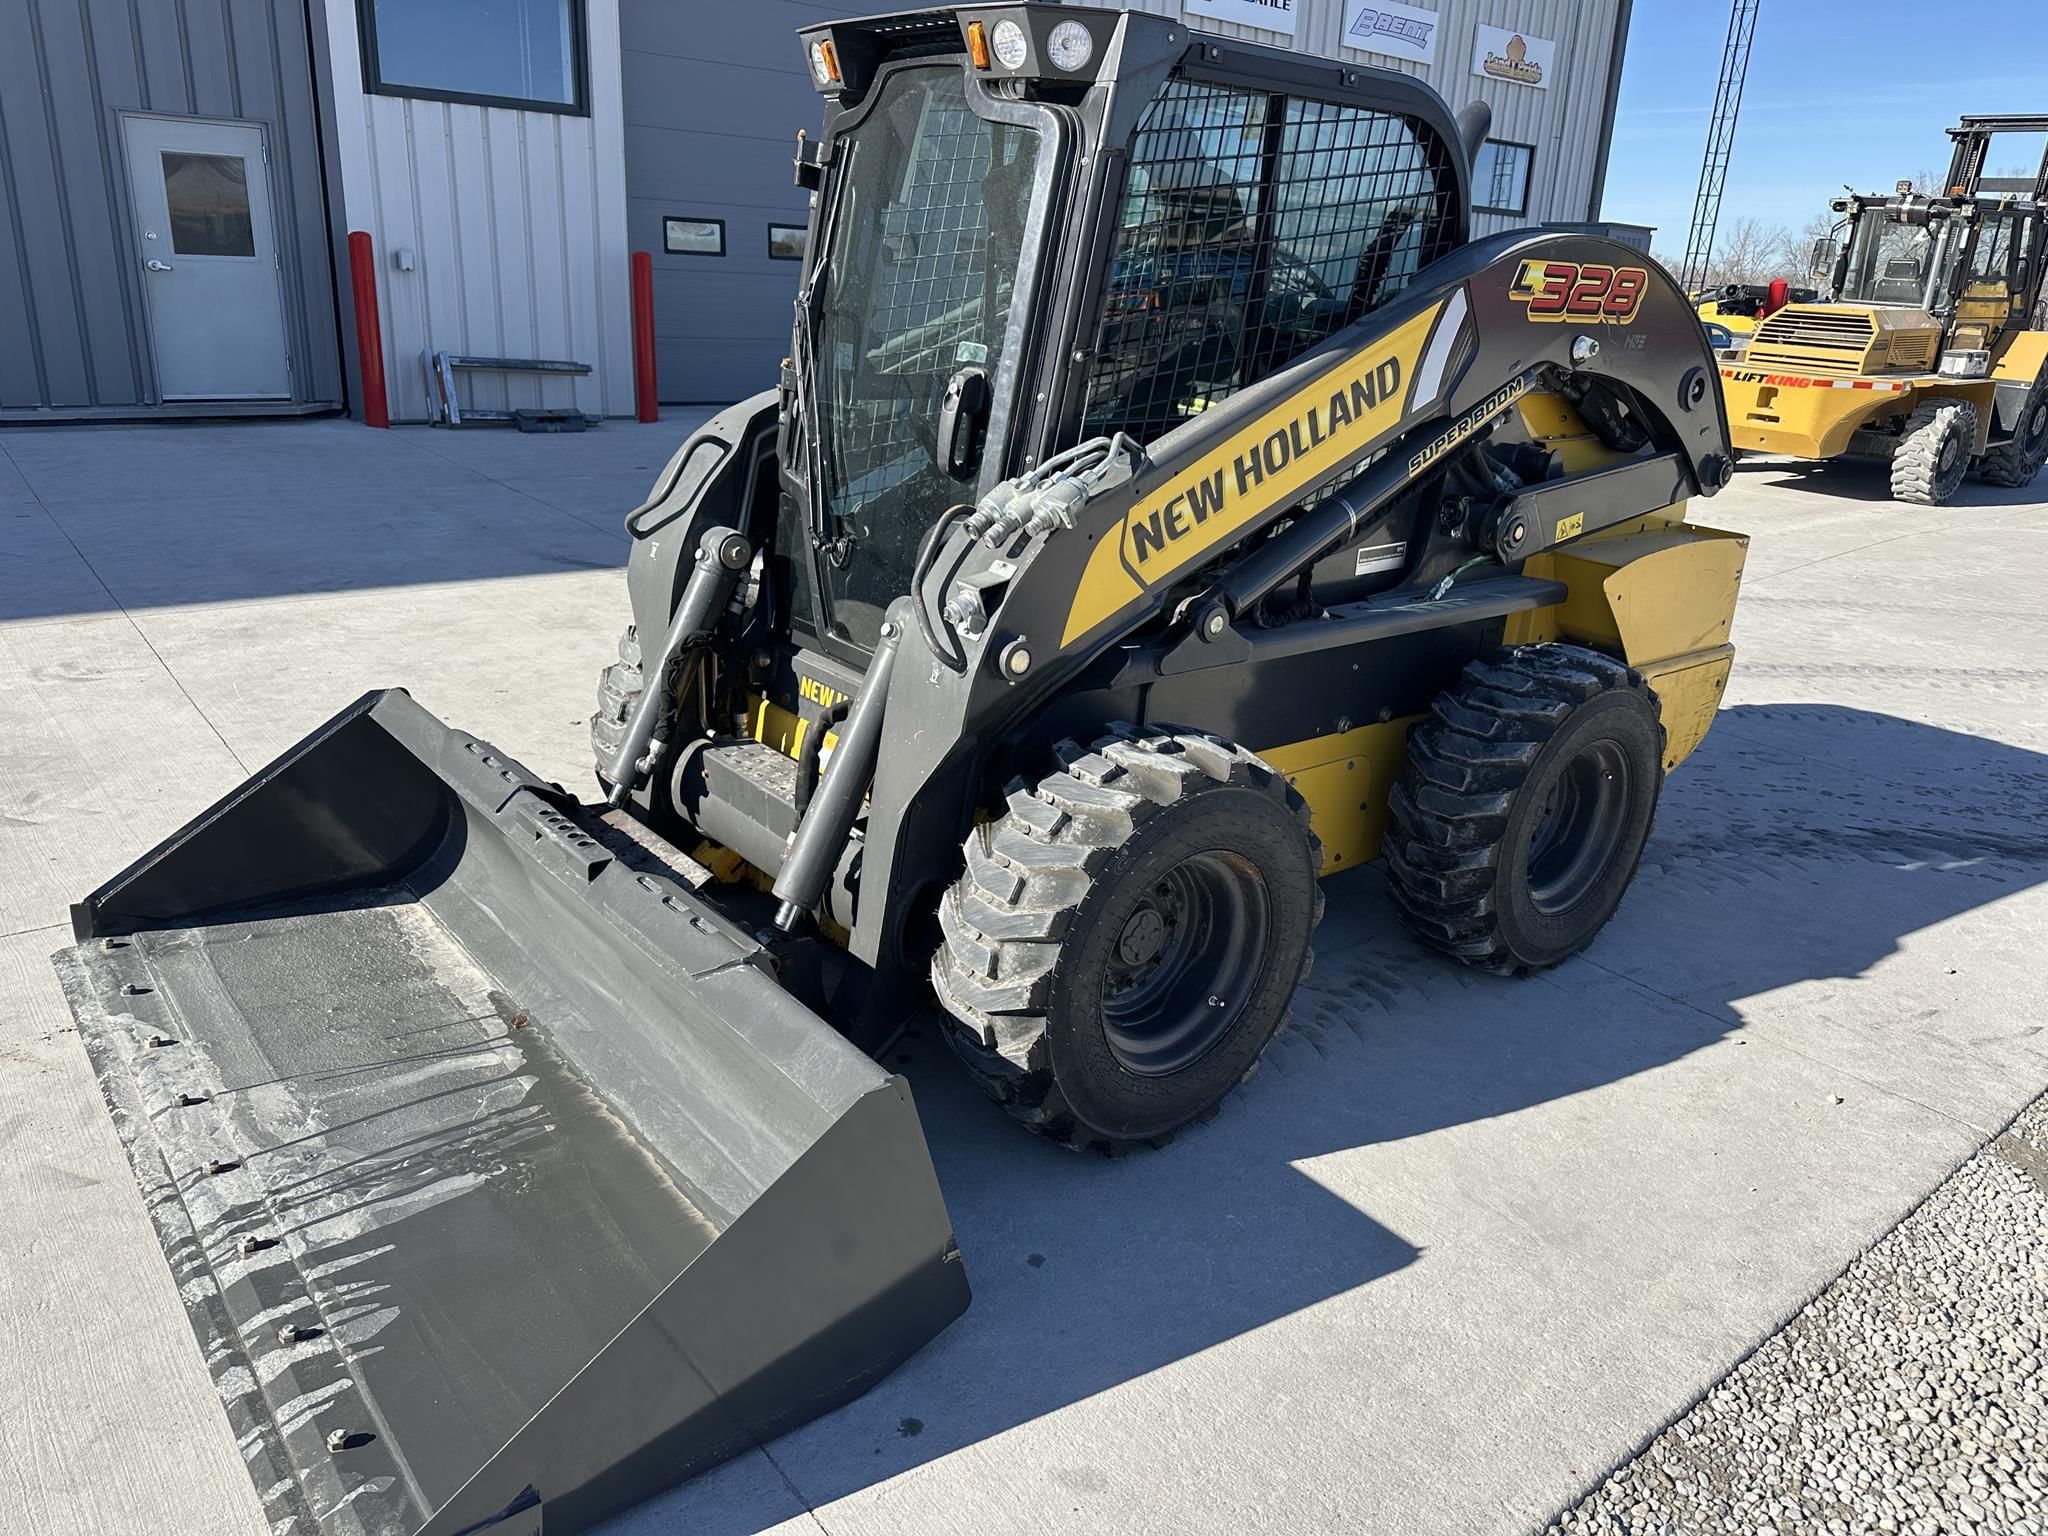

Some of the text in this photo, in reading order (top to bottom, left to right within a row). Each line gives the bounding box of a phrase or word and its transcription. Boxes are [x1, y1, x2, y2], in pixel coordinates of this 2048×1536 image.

[1349, 8, 1434, 42] BRENT
[1508, 259, 1648, 325] L328
[1733, 371, 1811, 388] LIFTKING
[1409, 376, 1524, 477] SUPER BOOM
[1131, 355, 1401, 564] NEW HOLLAND
[800, 675, 835, 708] NEW
